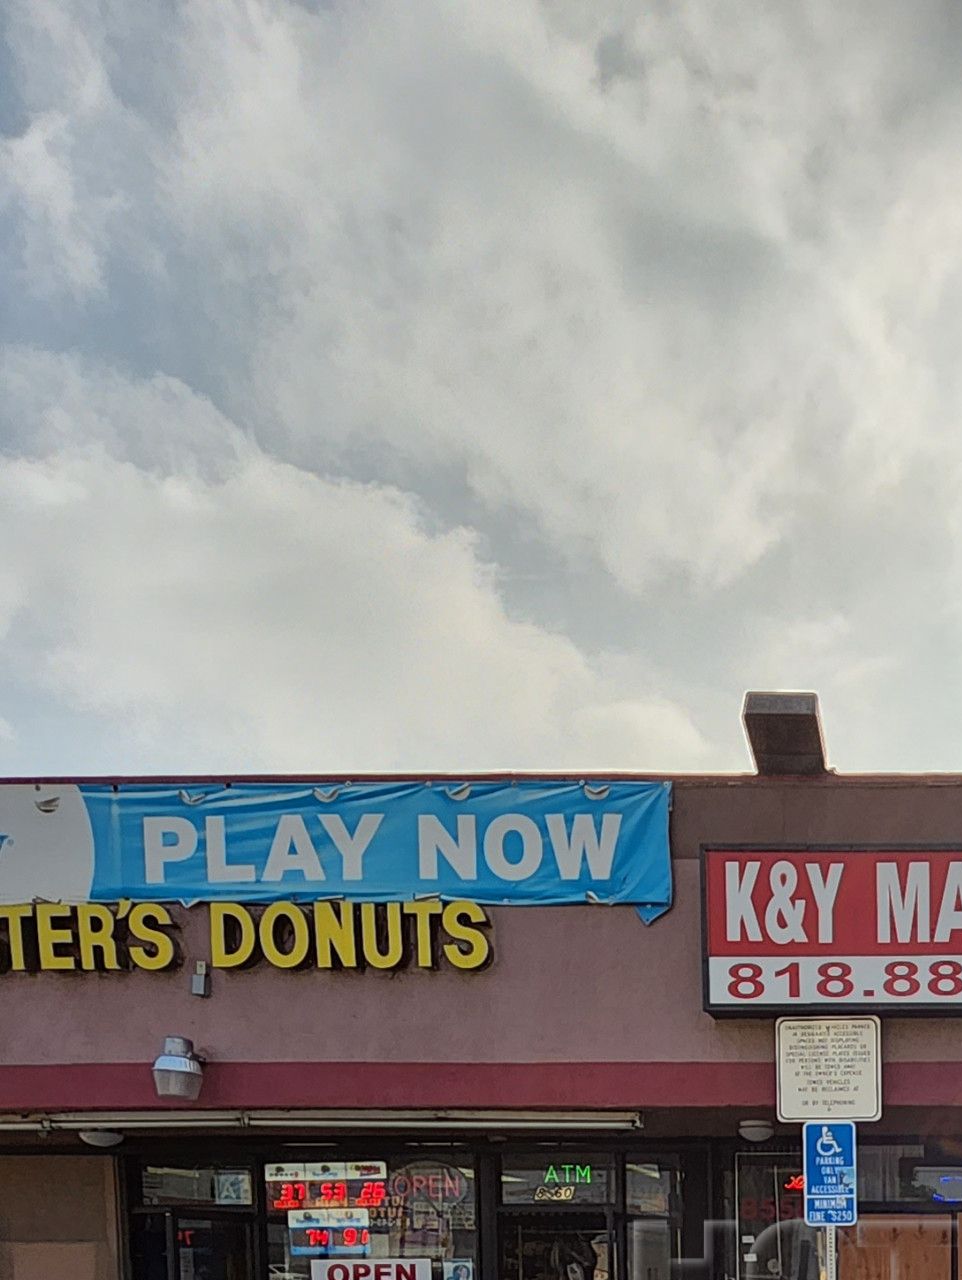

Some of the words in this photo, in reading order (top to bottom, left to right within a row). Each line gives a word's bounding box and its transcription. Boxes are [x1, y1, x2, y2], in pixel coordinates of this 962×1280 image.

[142, 813, 384, 884] PLAY
[417, 813, 623, 881] NOW
[725, 861, 844, 944] K&Y
[210, 901, 490, 969] DONUTS
[544, 1165, 591, 1183] ATM
[816, 1157, 844, 1165] PARKING
[394, 1175, 461, 1198] OPEN
